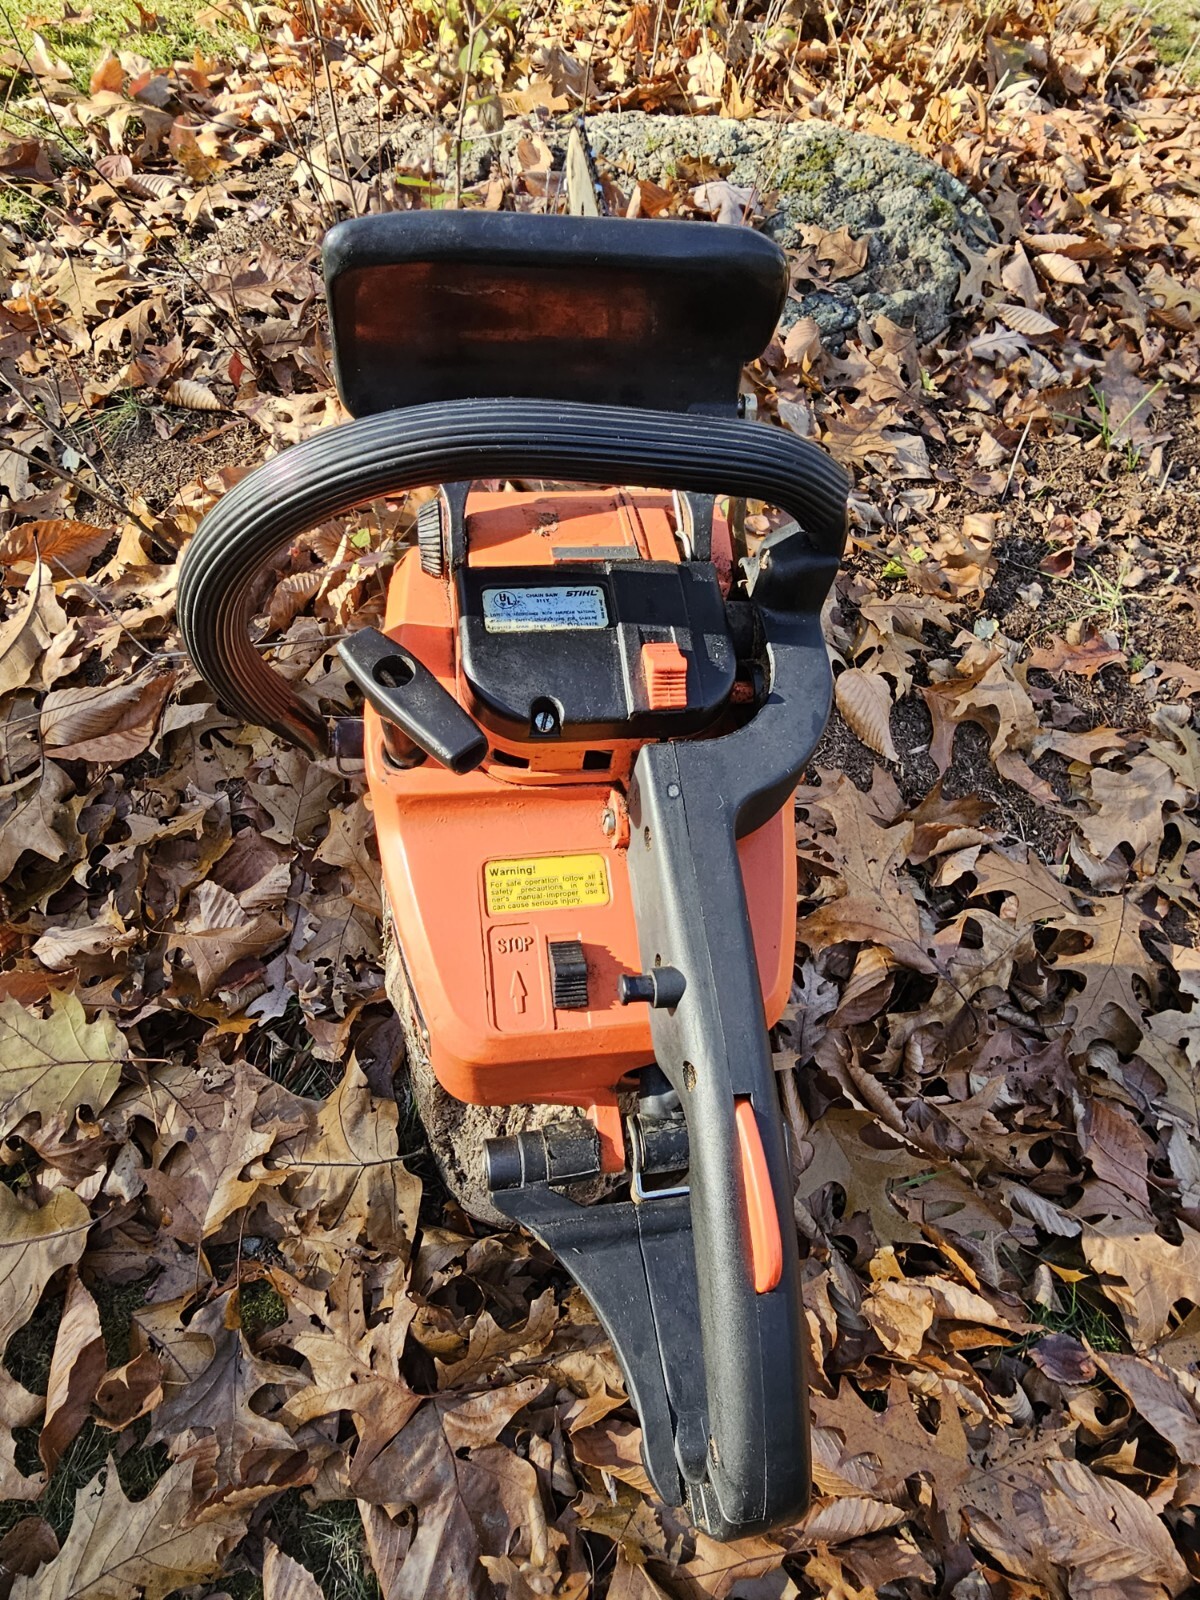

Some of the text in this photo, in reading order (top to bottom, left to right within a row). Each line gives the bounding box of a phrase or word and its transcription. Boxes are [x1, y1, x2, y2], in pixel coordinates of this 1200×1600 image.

[489, 866, 536, 877] Warning!
[506, 879, 521, 887] safe
[525, 877, 559, 886] operation
[491, 888, 513, 897] safety
[520, 884, 563, 894] precautions
[492, 895, 510, 903] ner's
[531, 898, 558, 907] serious
[560, 897, 583, 906] injury.
[498, 936, 534, 954] STOP
